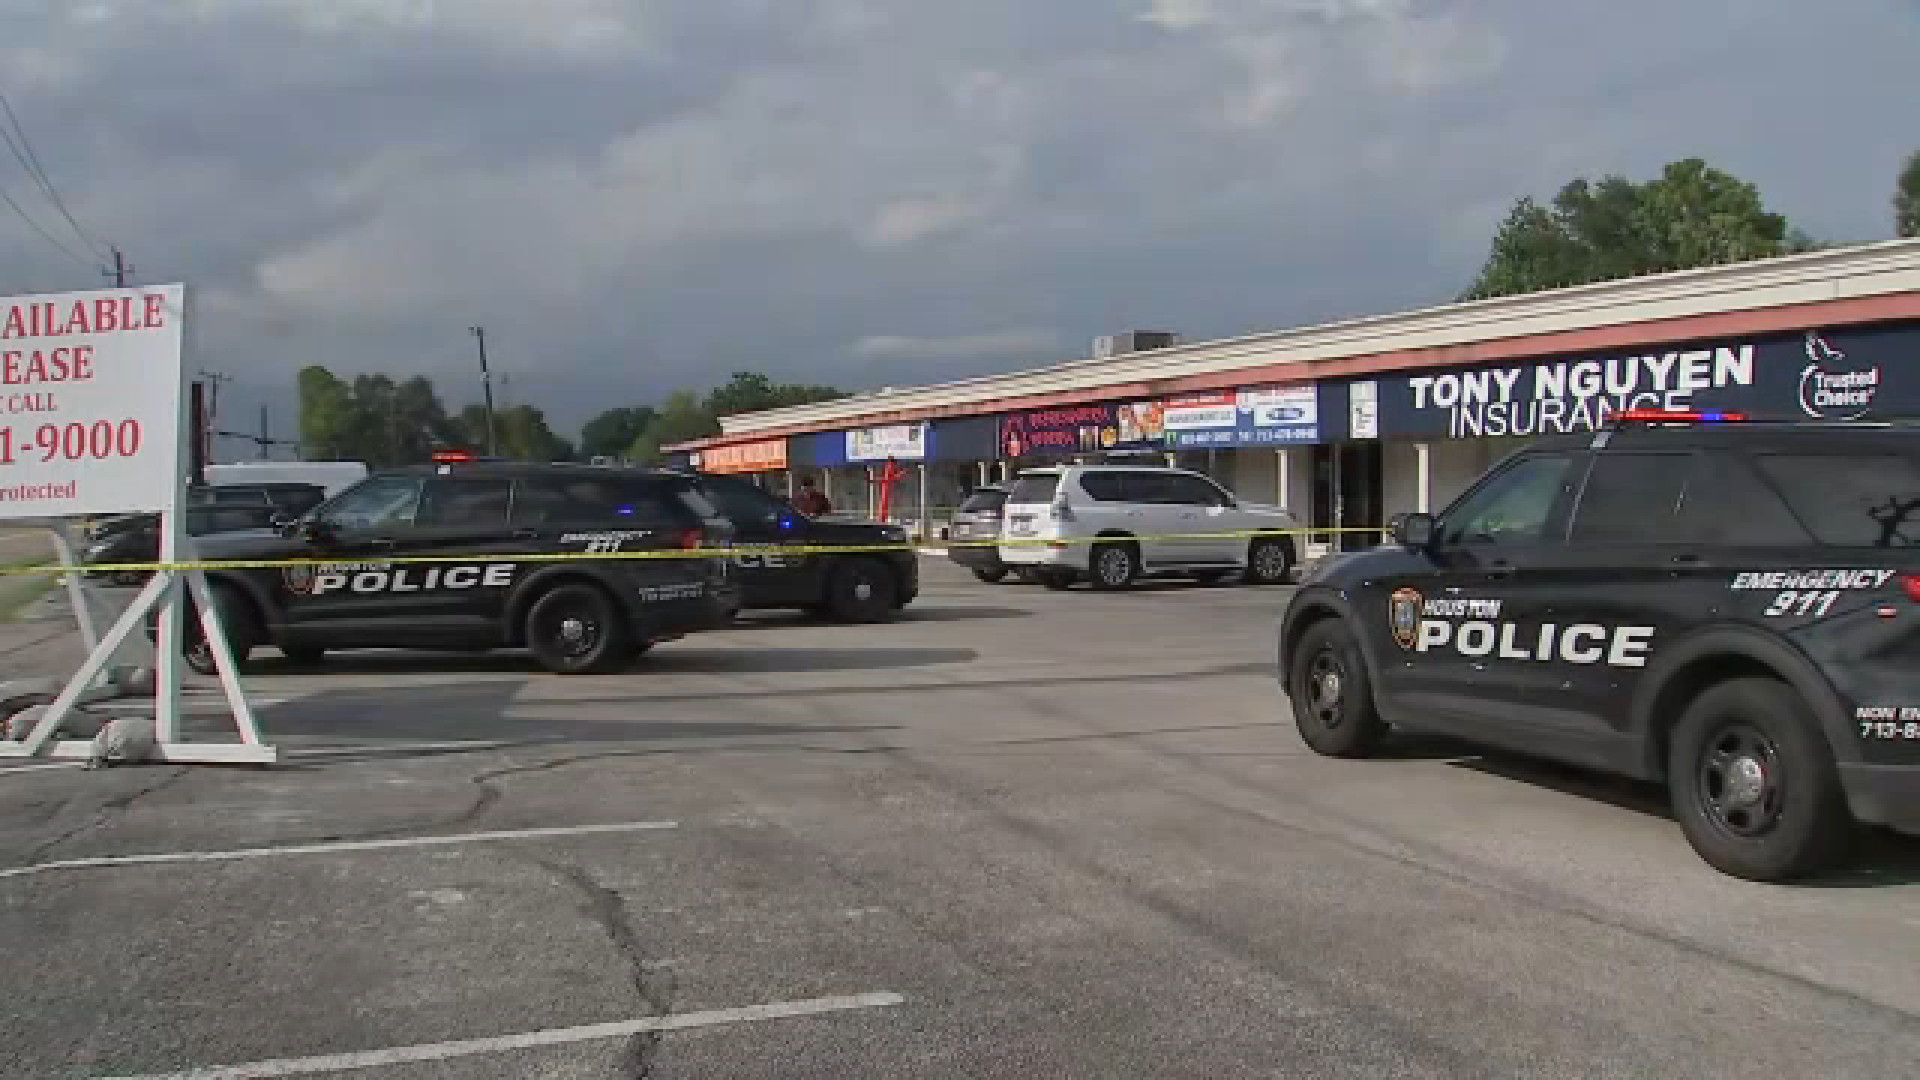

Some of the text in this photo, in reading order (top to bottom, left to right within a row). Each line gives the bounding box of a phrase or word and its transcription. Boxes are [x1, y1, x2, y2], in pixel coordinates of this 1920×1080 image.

[1409, 345, 1754, 409] TONY NGUYEN
[1815, 367, 1878, 388] Trusted
[8, 393, 58, 414] CALL
[312, 563, 517, 594] POLICE
[1731, 570, 1896, 588] EMERGENCY
[1422, 599, 1502, 618] HOUSTON
[1764, 591, 1840, 616] 911
[1416, 620, 1656, 667] POLICE
